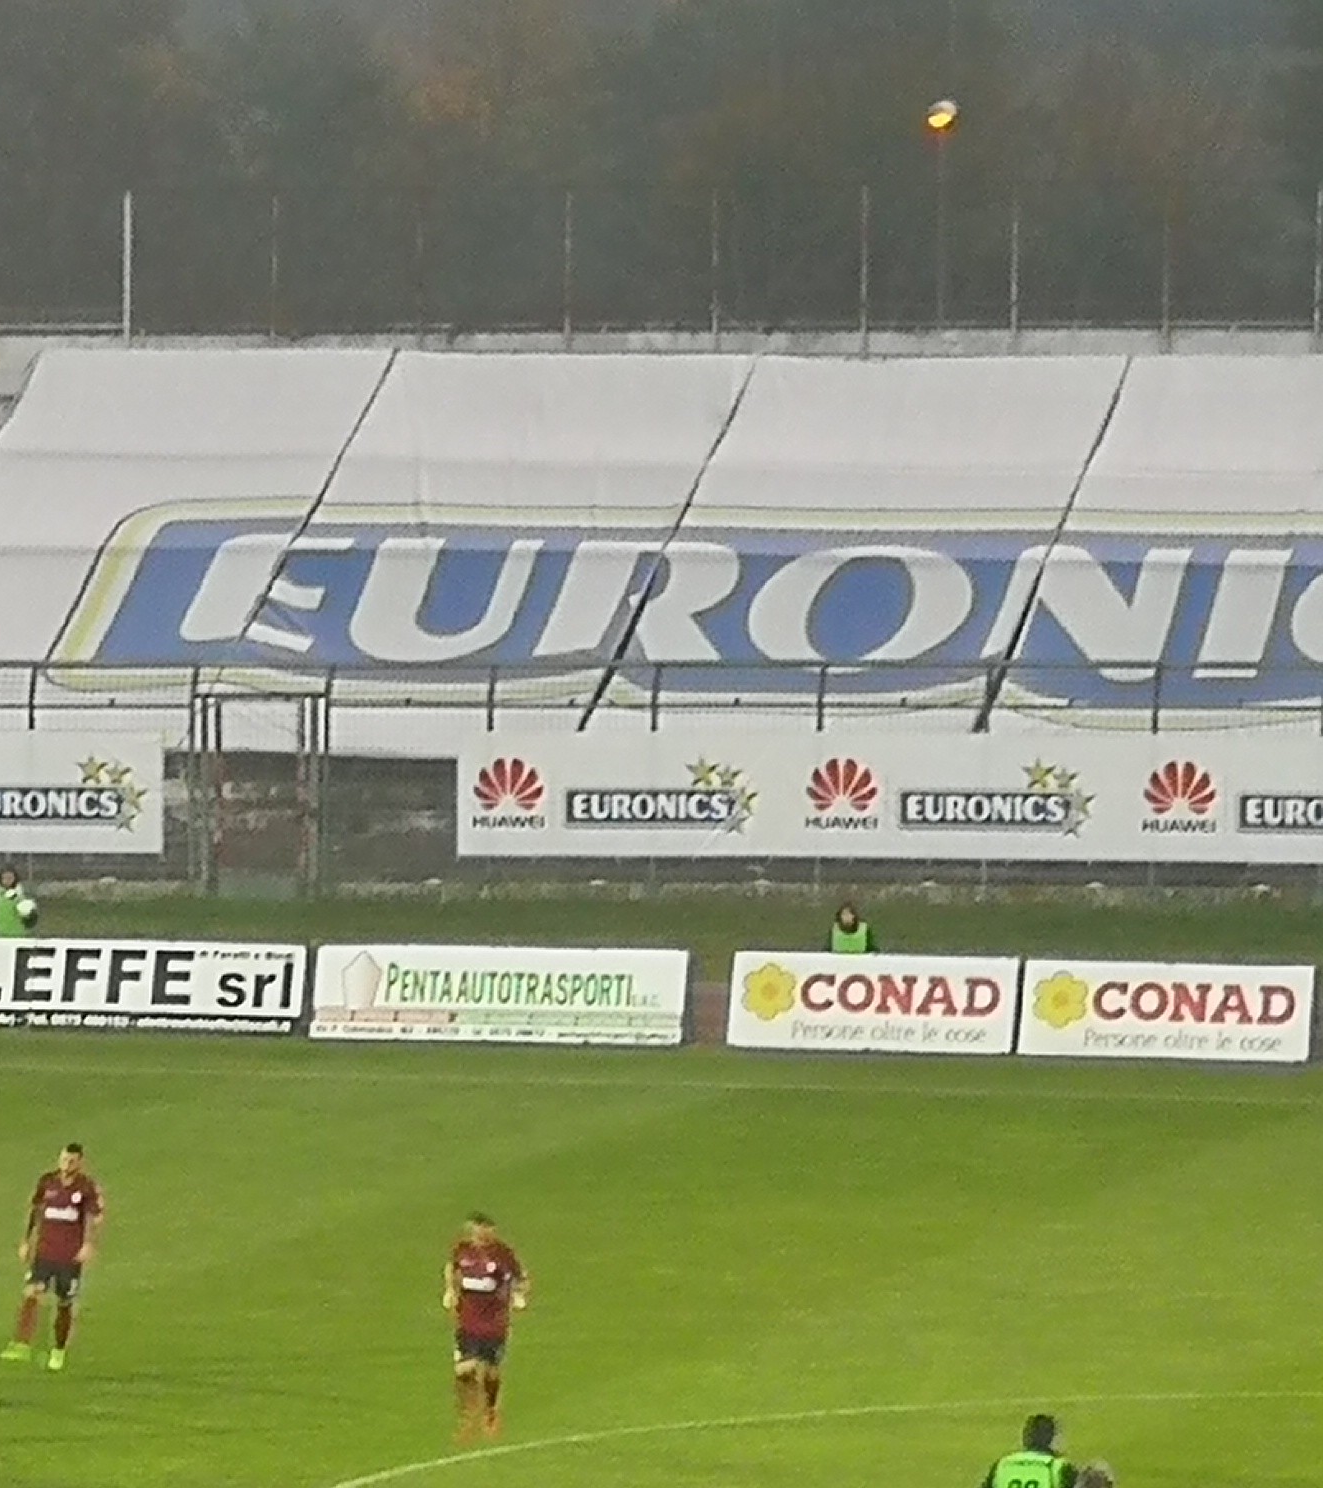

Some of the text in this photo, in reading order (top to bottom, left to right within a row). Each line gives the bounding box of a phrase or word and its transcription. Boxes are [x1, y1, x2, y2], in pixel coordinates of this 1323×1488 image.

[181, 533, 1323, 682] EURONI
[572, 794, 728, 820] EURONICS
[907, 795, 1065, 822] EURONICS
[473, 815, 545, 829] HUAWEI
[805, 817, 878, 830] HUAWEI
[1142, 818, 1216, 833] HUAWEI
[216, 962, 293, 1010] srl
[800, 974, 1000, 1017] CONAD
[1093, 981, 1296, 1025] CONAD
[791, 1019, 986, 1044] Persone oltre le cose
[1083, 1027, 1282, 1051] Persone oltre le cose
